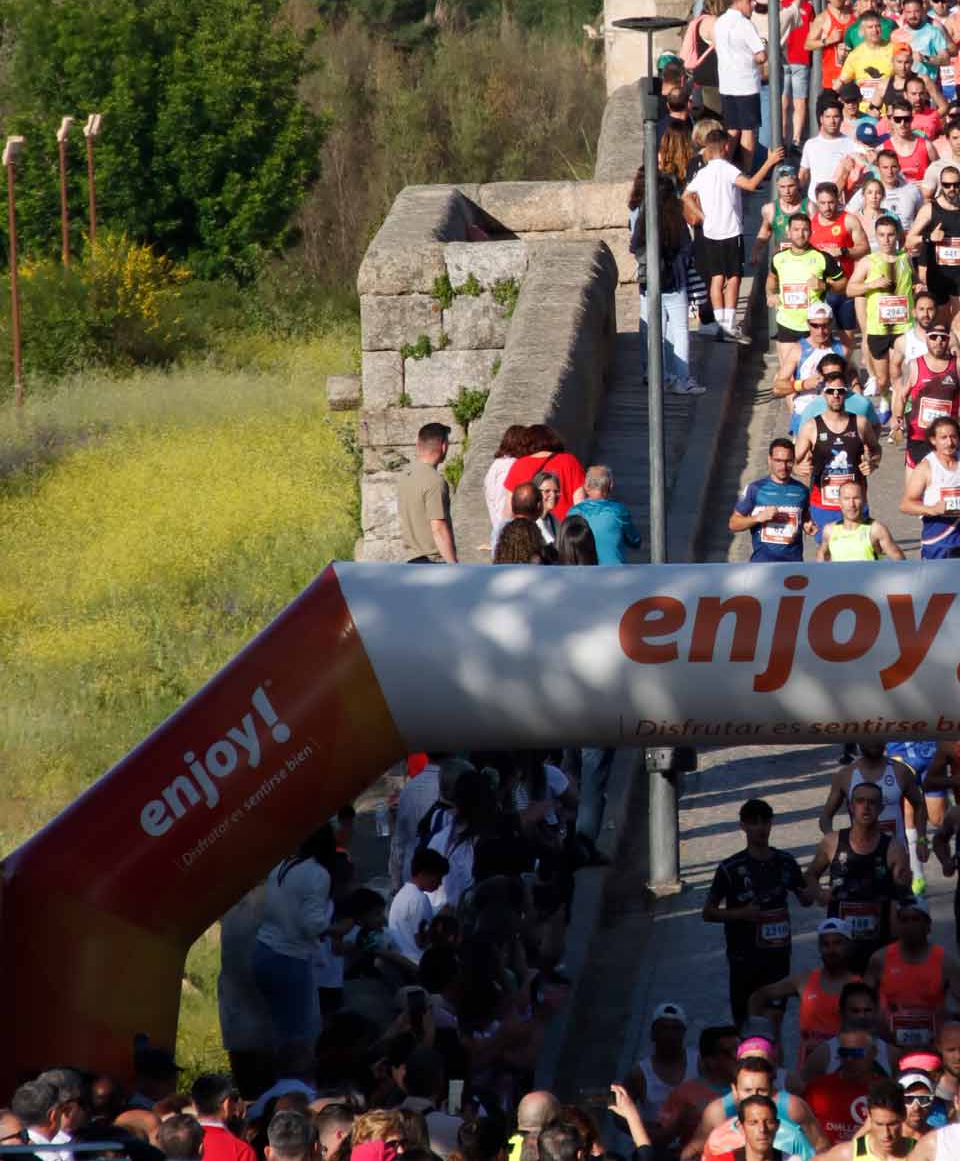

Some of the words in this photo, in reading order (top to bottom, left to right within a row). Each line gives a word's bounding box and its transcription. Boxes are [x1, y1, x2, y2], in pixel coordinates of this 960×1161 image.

[635, 719, 763, 737] Disfrutar
[773, 721, 801, 736] es
[808, 716, 929, 735] sentirse
[139, 686, 291, 837] enjoy!
[285, 745, 313, 772] bien
